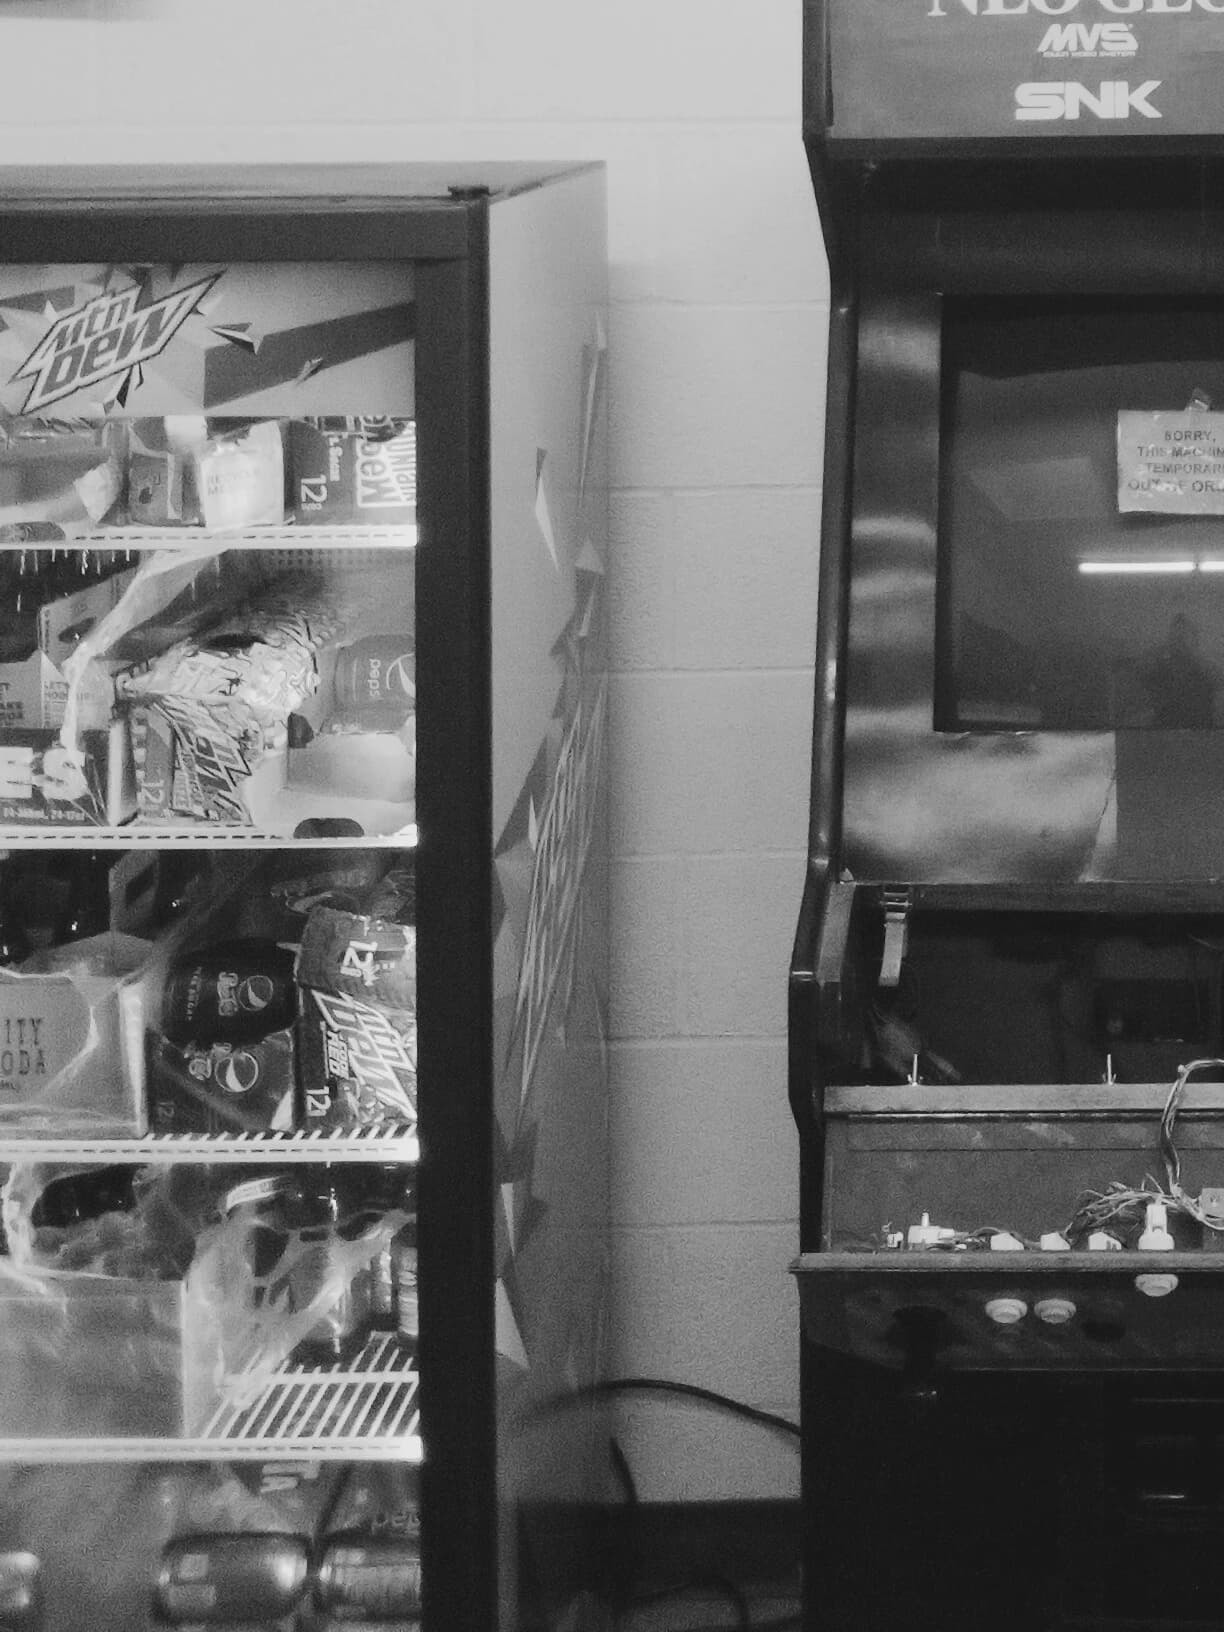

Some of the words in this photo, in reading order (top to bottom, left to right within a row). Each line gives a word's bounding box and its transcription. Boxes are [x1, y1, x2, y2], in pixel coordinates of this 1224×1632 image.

[1037, 23, 1139, 52] MVS
[1015, 79, 1163, 120] SNK
[300, 473, 328, 503] 12
